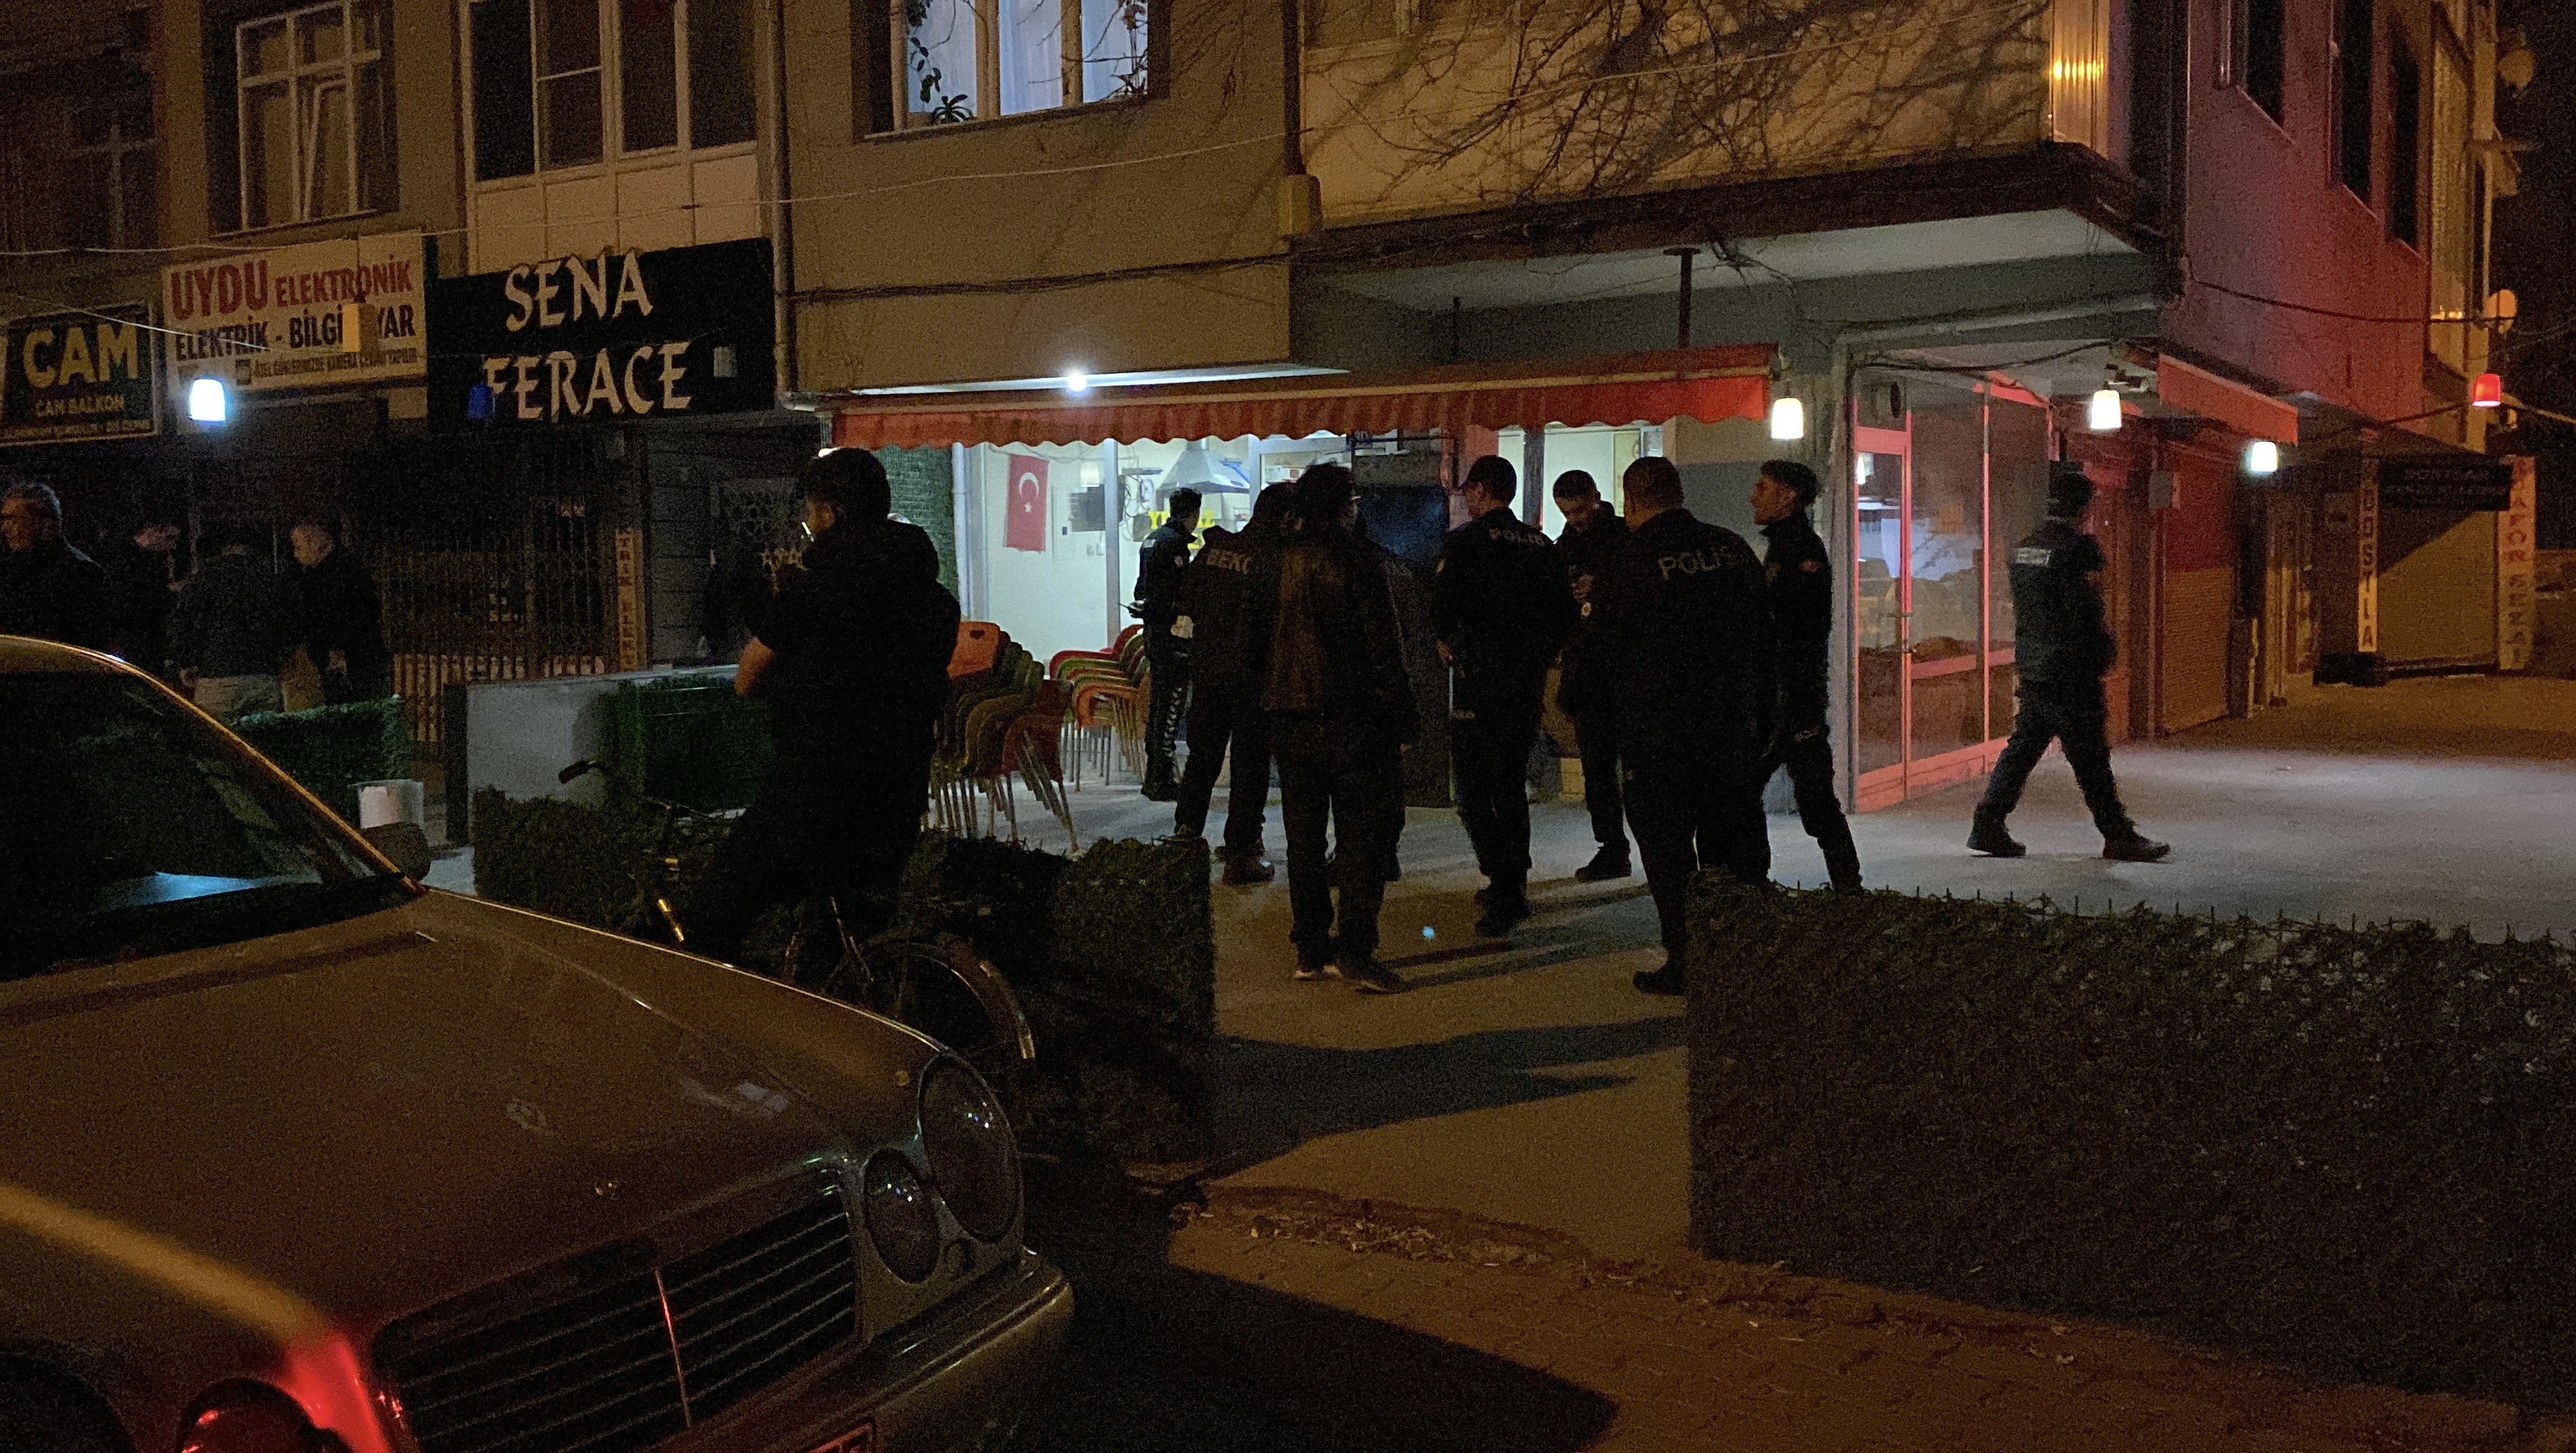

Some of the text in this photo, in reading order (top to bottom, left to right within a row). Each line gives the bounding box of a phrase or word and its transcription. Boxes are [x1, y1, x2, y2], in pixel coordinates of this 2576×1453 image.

[171, 254, 412, 320] UYDU ELEKTRONİK
[505, 249, 654, 333] SENA
[23, 323, 138, 388] CAM
[483, 340, 693, 423] FERACE
